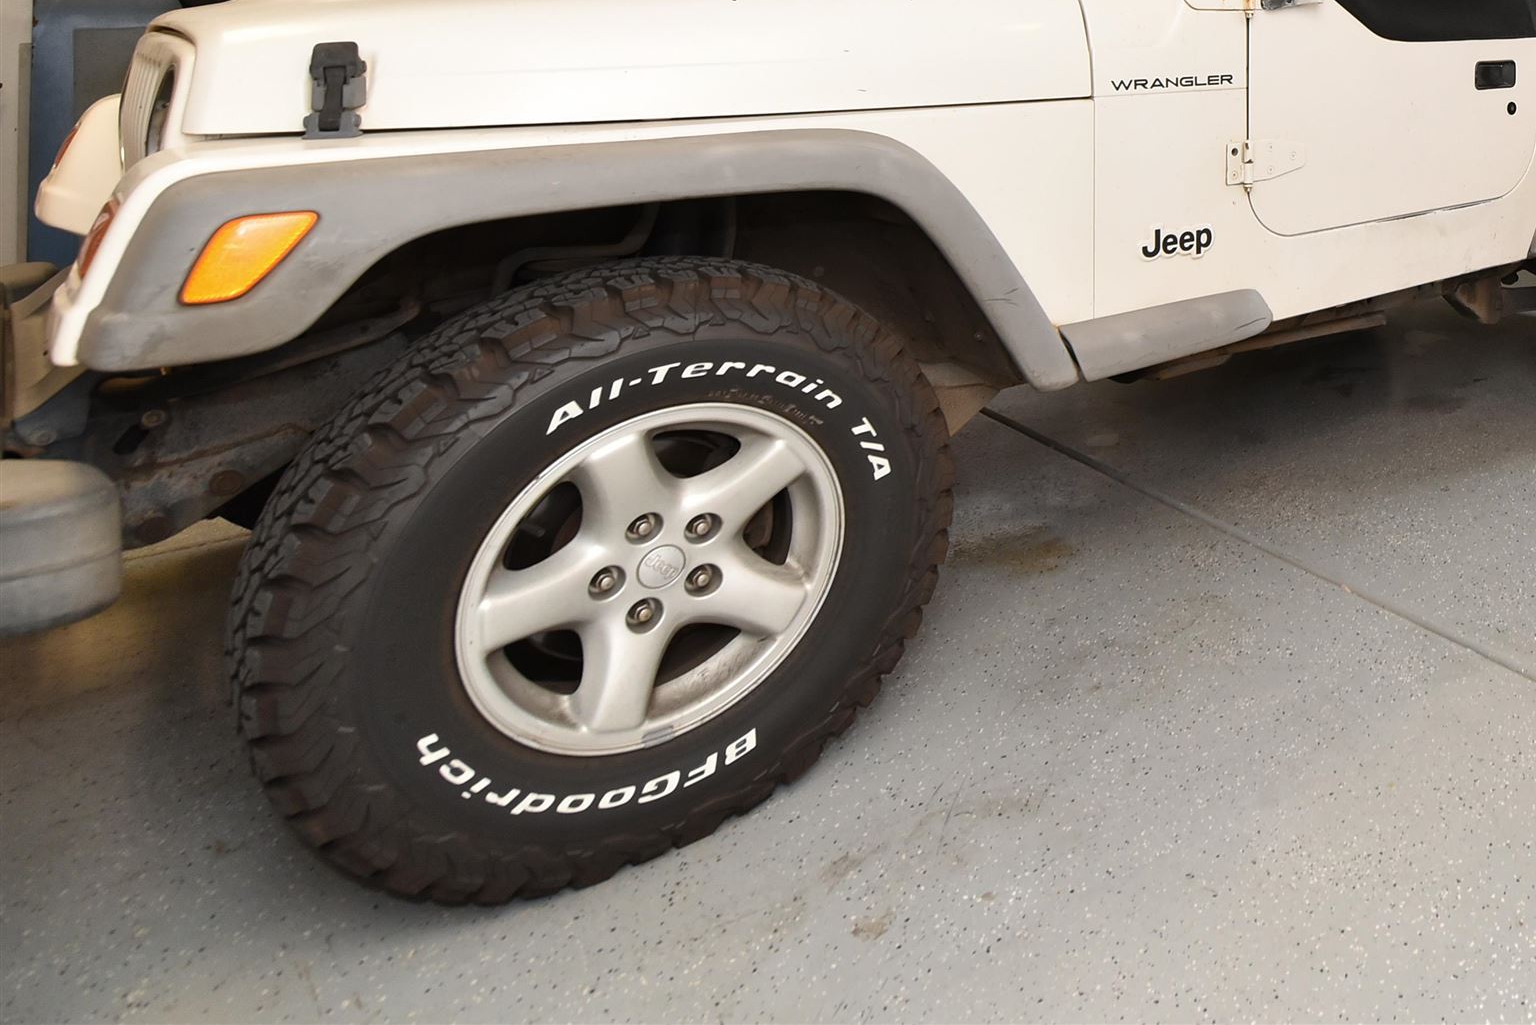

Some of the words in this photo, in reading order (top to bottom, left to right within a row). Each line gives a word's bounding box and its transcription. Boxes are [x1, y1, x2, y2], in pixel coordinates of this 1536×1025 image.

[1111, 74, 1234, 90] WRANGLER
[1142, 227, 1213, 258] Jeep
[546, 361, 843, 436] All-Terrain
[850, 416, 892, 481] T/A
[644, 553, 680, 579] Jeep
[416, 727, 757, 815] BFGoodrich
